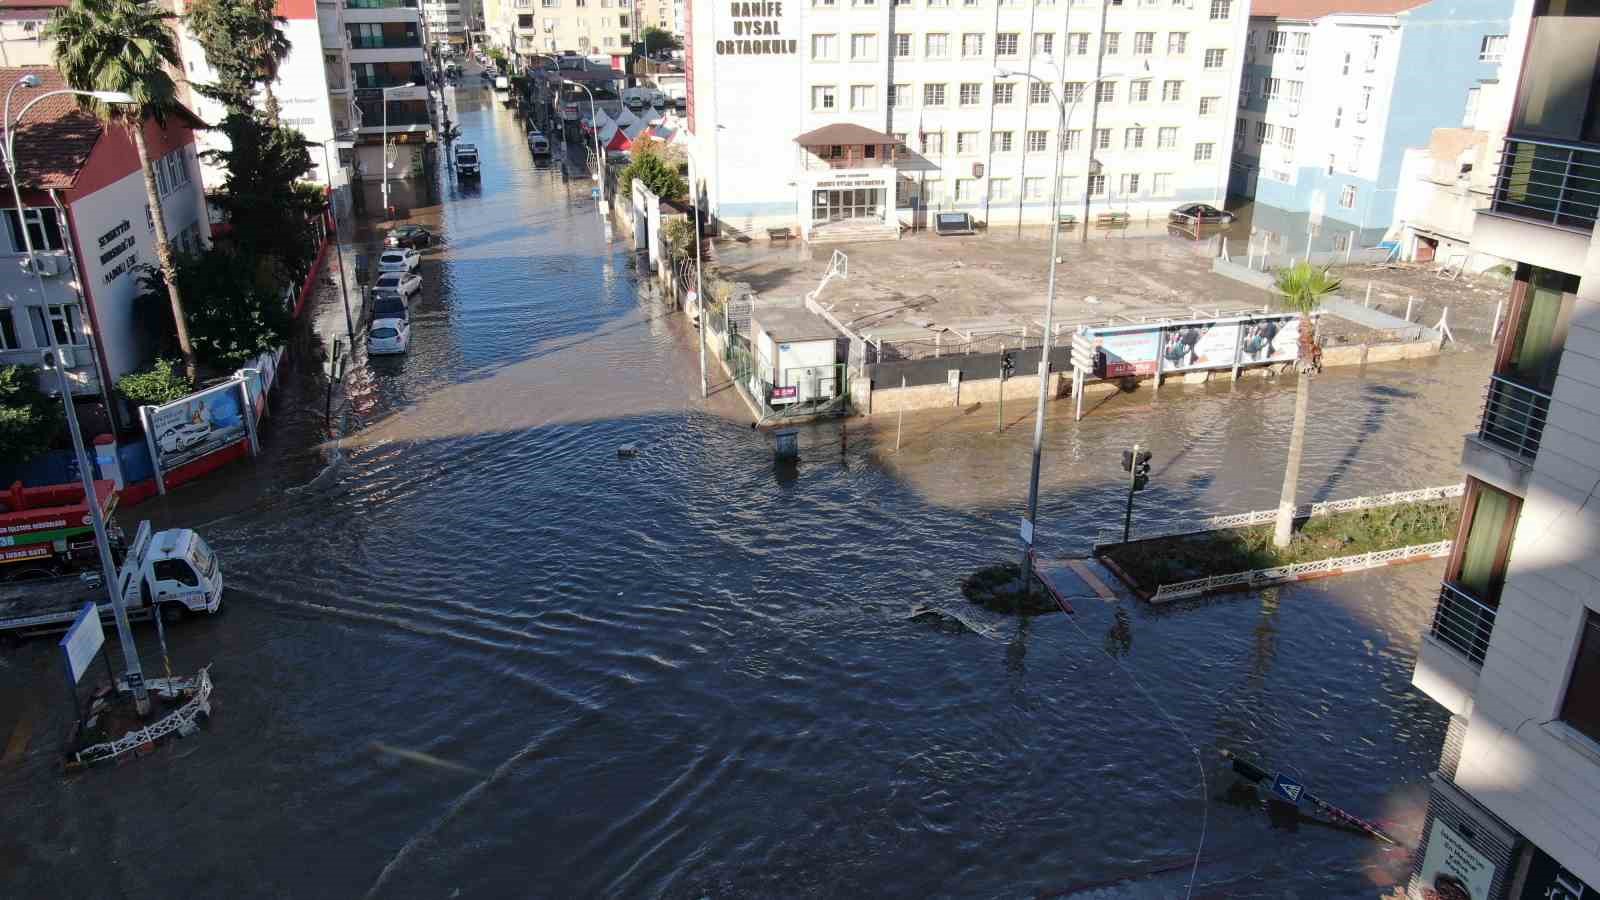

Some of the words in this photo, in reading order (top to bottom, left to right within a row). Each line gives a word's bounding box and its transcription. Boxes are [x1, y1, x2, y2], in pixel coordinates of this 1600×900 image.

[731, 0, 782, 17] HANİFE
[734, 21, 781, 35] UYSAL
[716, 40, 797, 55] ORTAOKULU
